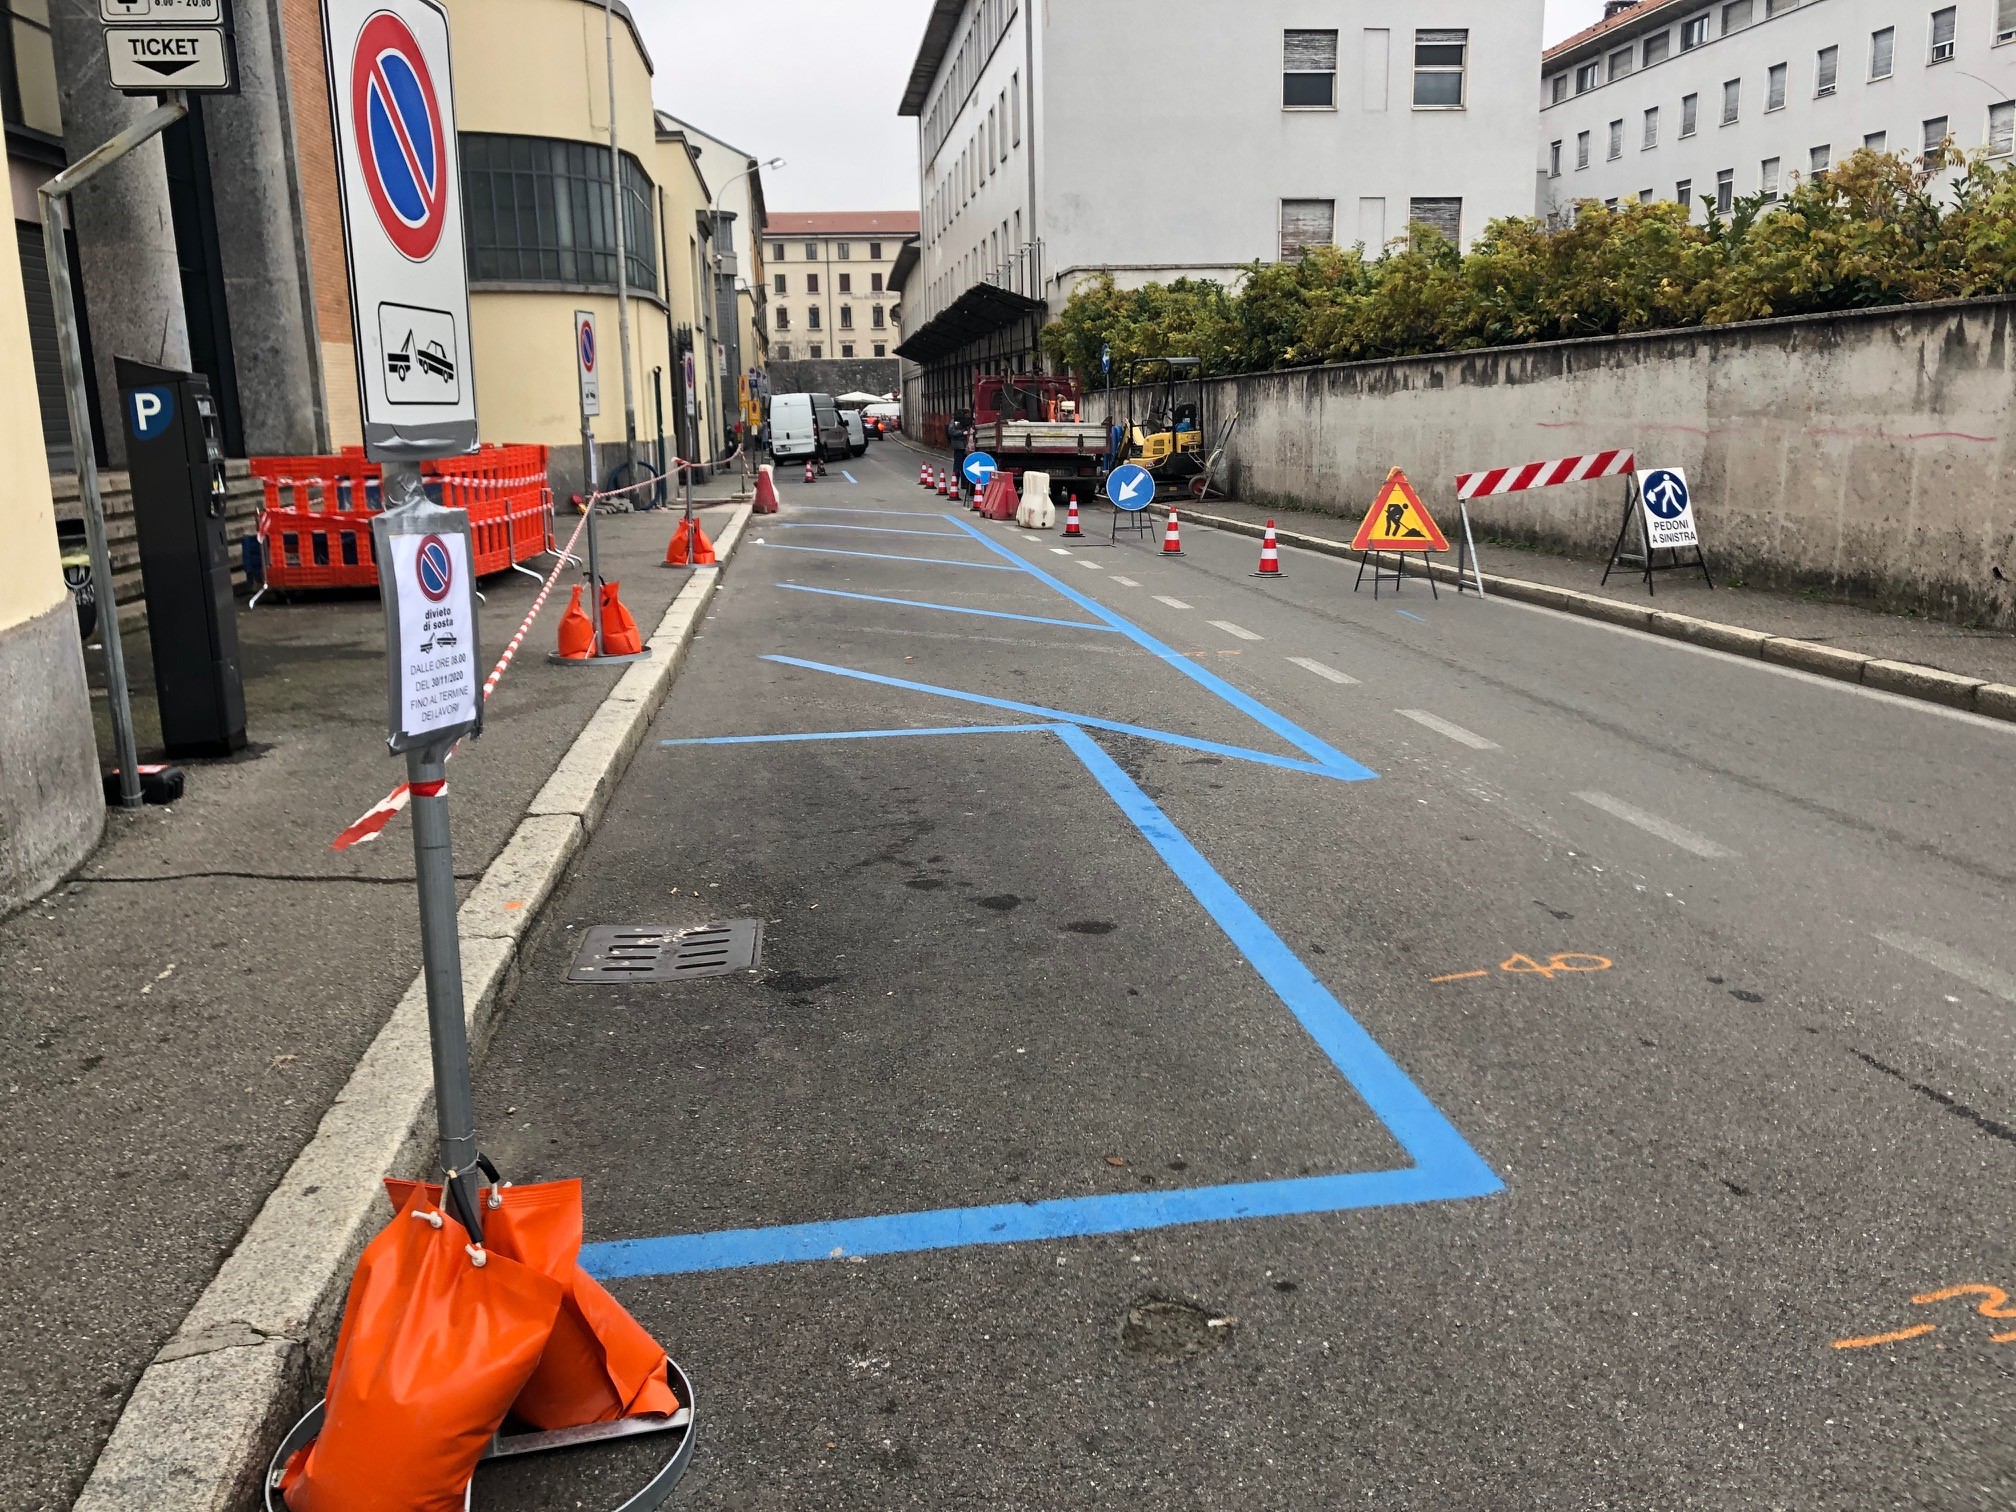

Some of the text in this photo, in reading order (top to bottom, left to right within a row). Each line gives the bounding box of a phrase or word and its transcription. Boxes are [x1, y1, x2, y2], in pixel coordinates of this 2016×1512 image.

[128, 38, 199, 55] TICKET
[134, 392, 162, 431] P
[1654, 520, 1689, 531] PEDONI
[1652, 532, 1696, 544] A SINISTRA
[425, 607, 451, 620] divieto
[423, 618, 454, 631] di sosta
[410, 661, 434, 675] DALLE
[435, 656, 450, 669] ORE
[415, 671, 463, 692] DEL 30/11/2020
[410, 684, 469, 711] FINO AL TERMINE
[421, 702, 459, 722] DEI LAVORI
